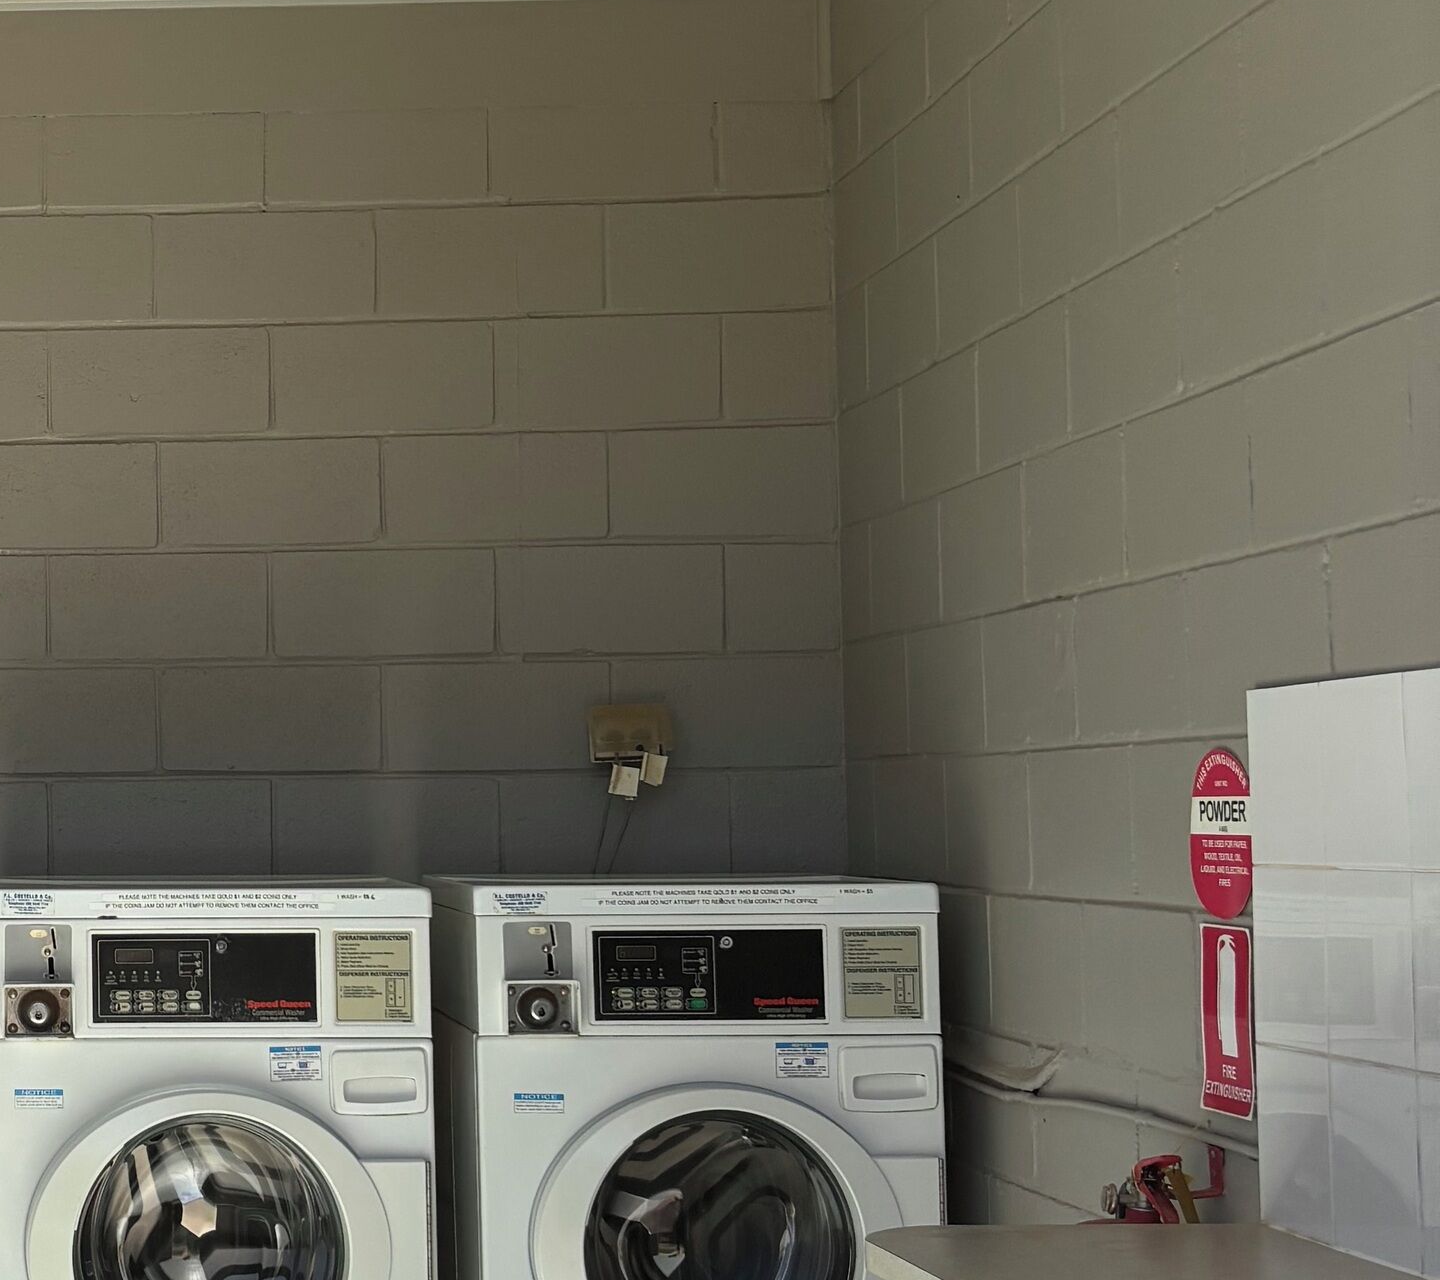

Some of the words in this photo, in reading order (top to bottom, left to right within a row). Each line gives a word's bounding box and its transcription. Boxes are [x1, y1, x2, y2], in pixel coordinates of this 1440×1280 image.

[1196, 767, 1207, 790] THIS
[1204, 754, 1246, 790] EXTINGUISHER
[1199, 801, 1246, 822] POWDER
[1219, 879, 1231, 887] FIRES
[247, 1000, 278, 1009] Speed
[280, 1000, 311, 1008] Queen
[754, 998, 785, 1006] Speed
[787, 997, 818, 1005] Queen
[1223, 1064, 1237, 1080] FIRE
[1206, 1080, 1251, 1103] EXTINGUISHER
